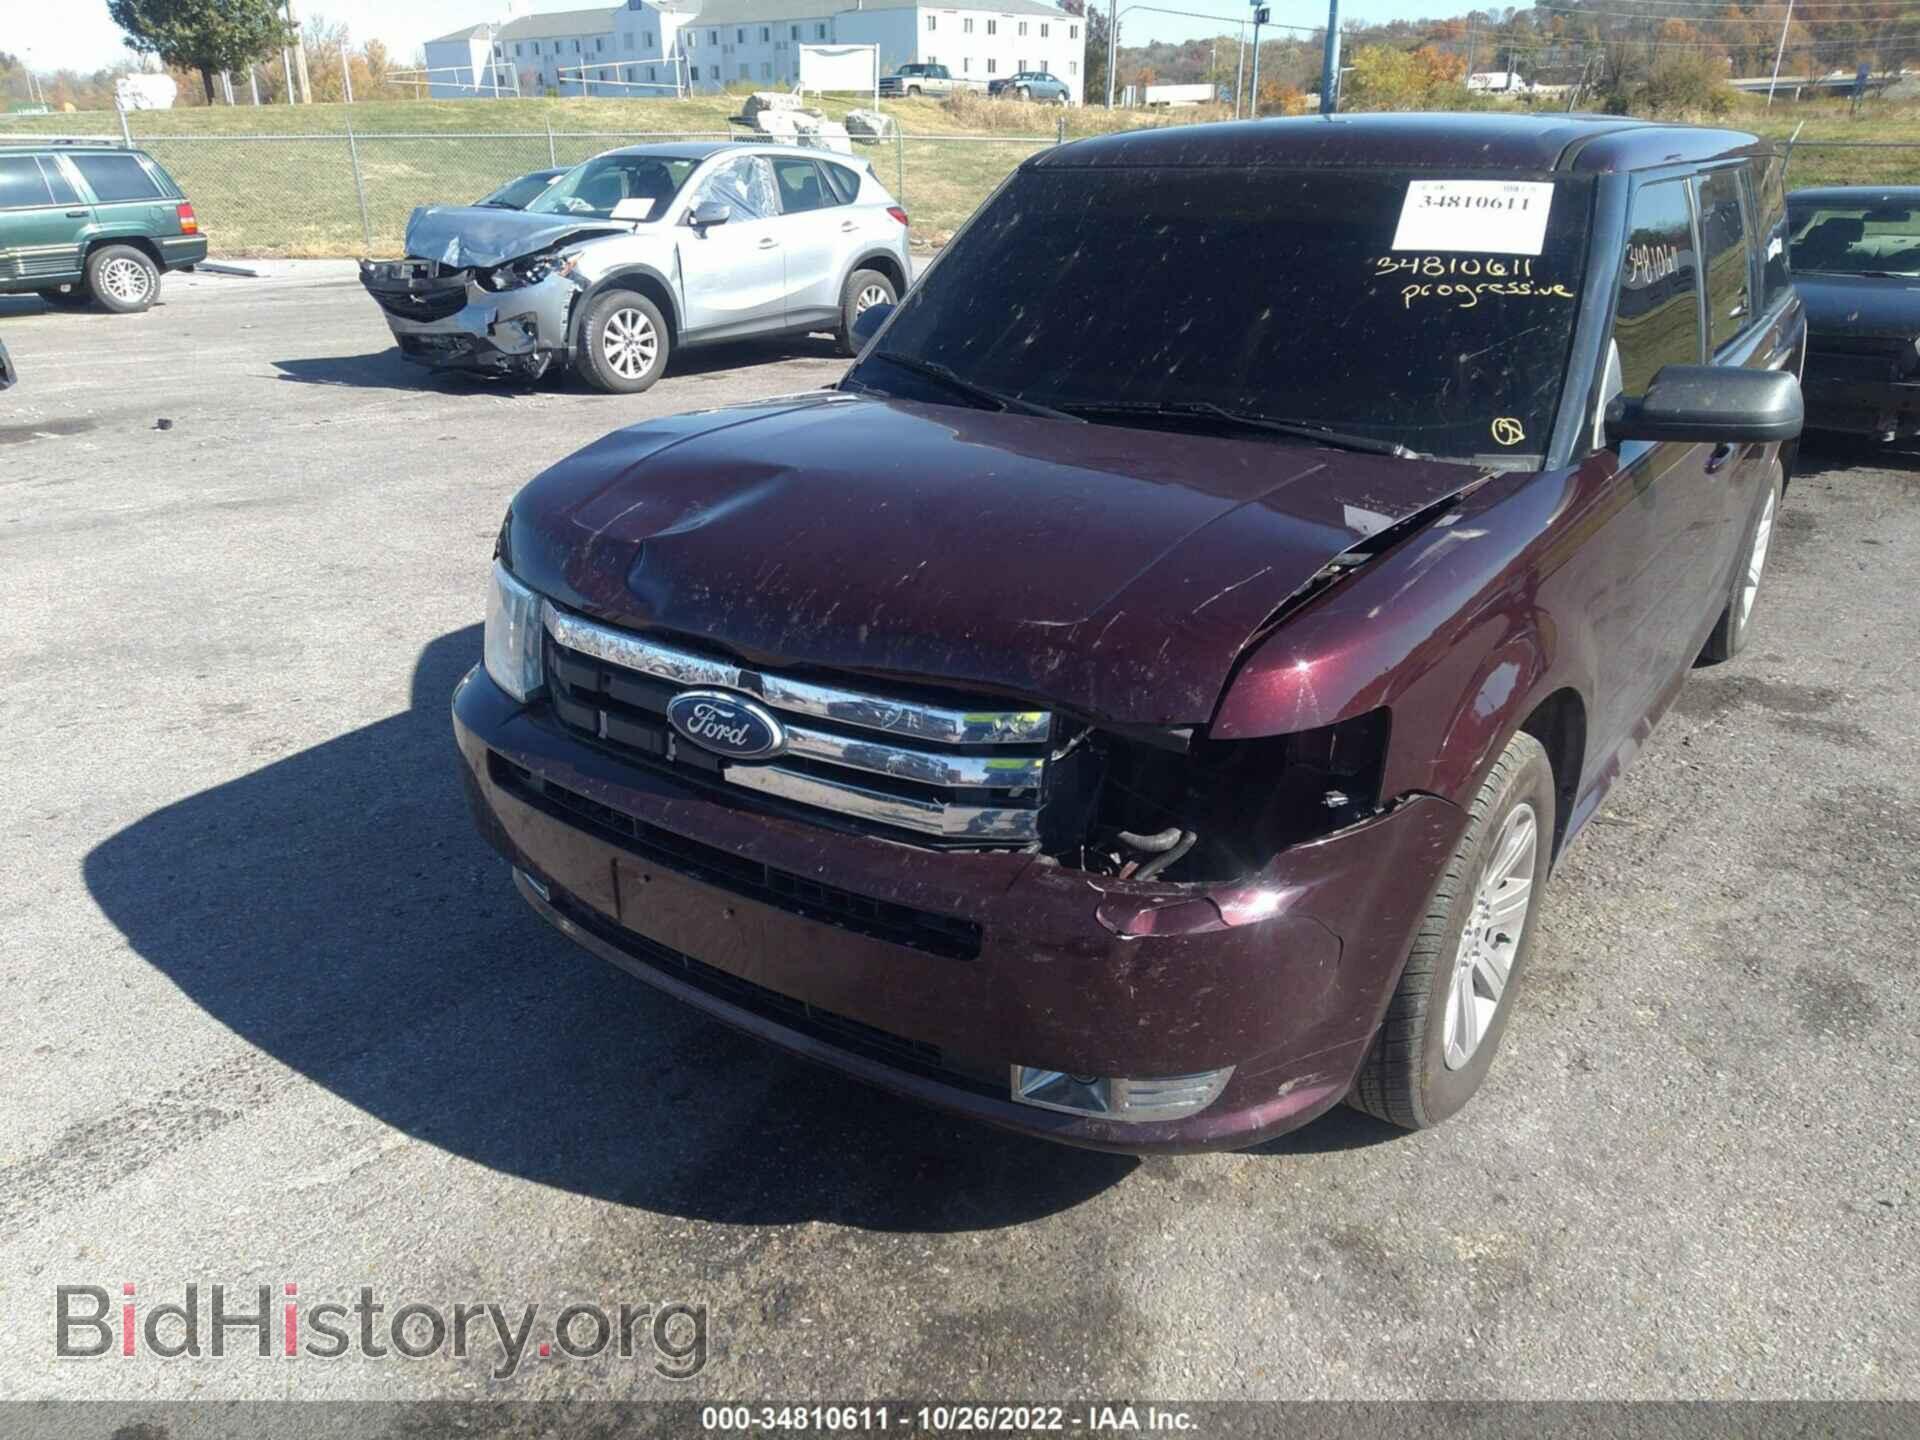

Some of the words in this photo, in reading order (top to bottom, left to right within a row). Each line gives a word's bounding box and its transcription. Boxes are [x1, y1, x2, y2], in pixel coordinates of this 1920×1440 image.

[1418, 194, 1529, 211] 34810611
[1374, 255, 1531, 277] 34810611
[1401, 279, 1575, 309] progressive
[686, 703, 750, 746] Ford
